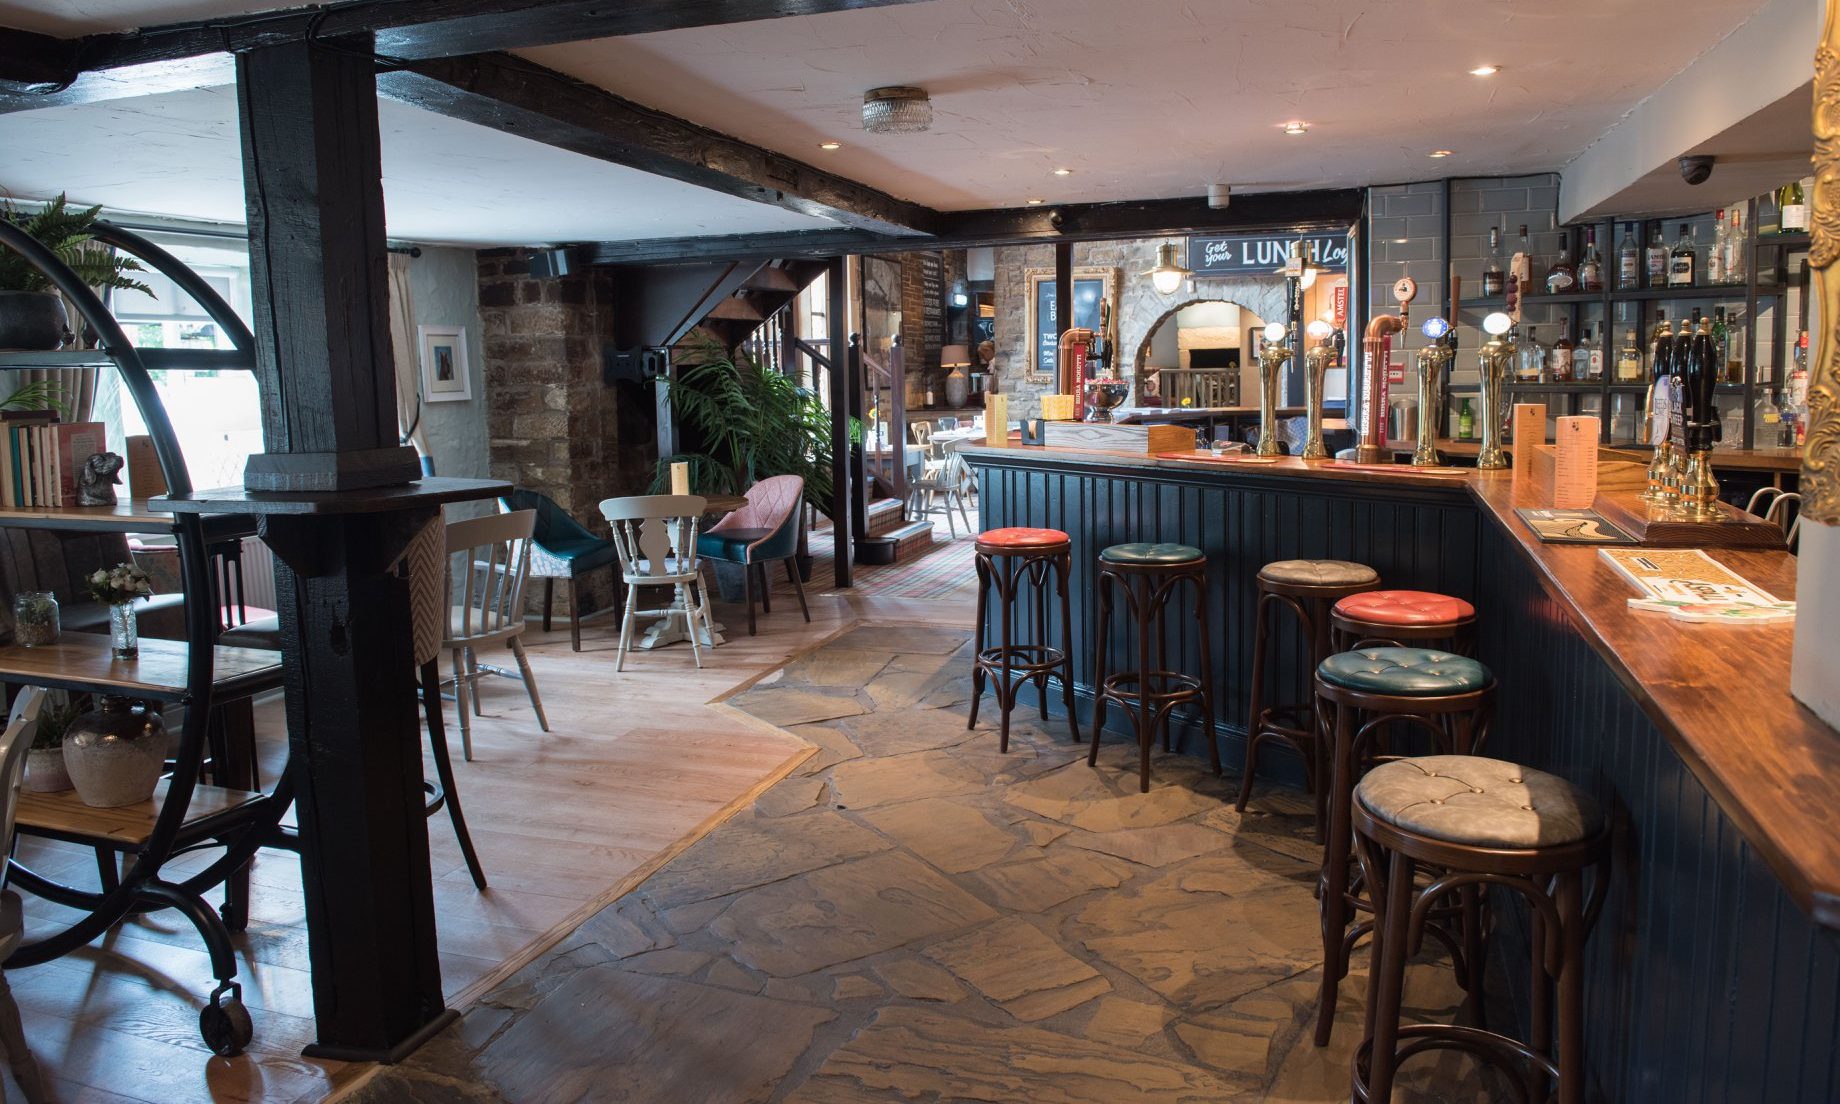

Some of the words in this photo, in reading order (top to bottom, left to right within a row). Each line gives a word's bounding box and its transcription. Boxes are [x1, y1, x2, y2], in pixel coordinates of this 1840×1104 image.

[1205, 241, 1228, 255] Get
[1242, 239, 1320, 264] LUNH
[1205, 251, 1232, 267] your
[1337, 287, 1345, 317] AMSTEL
